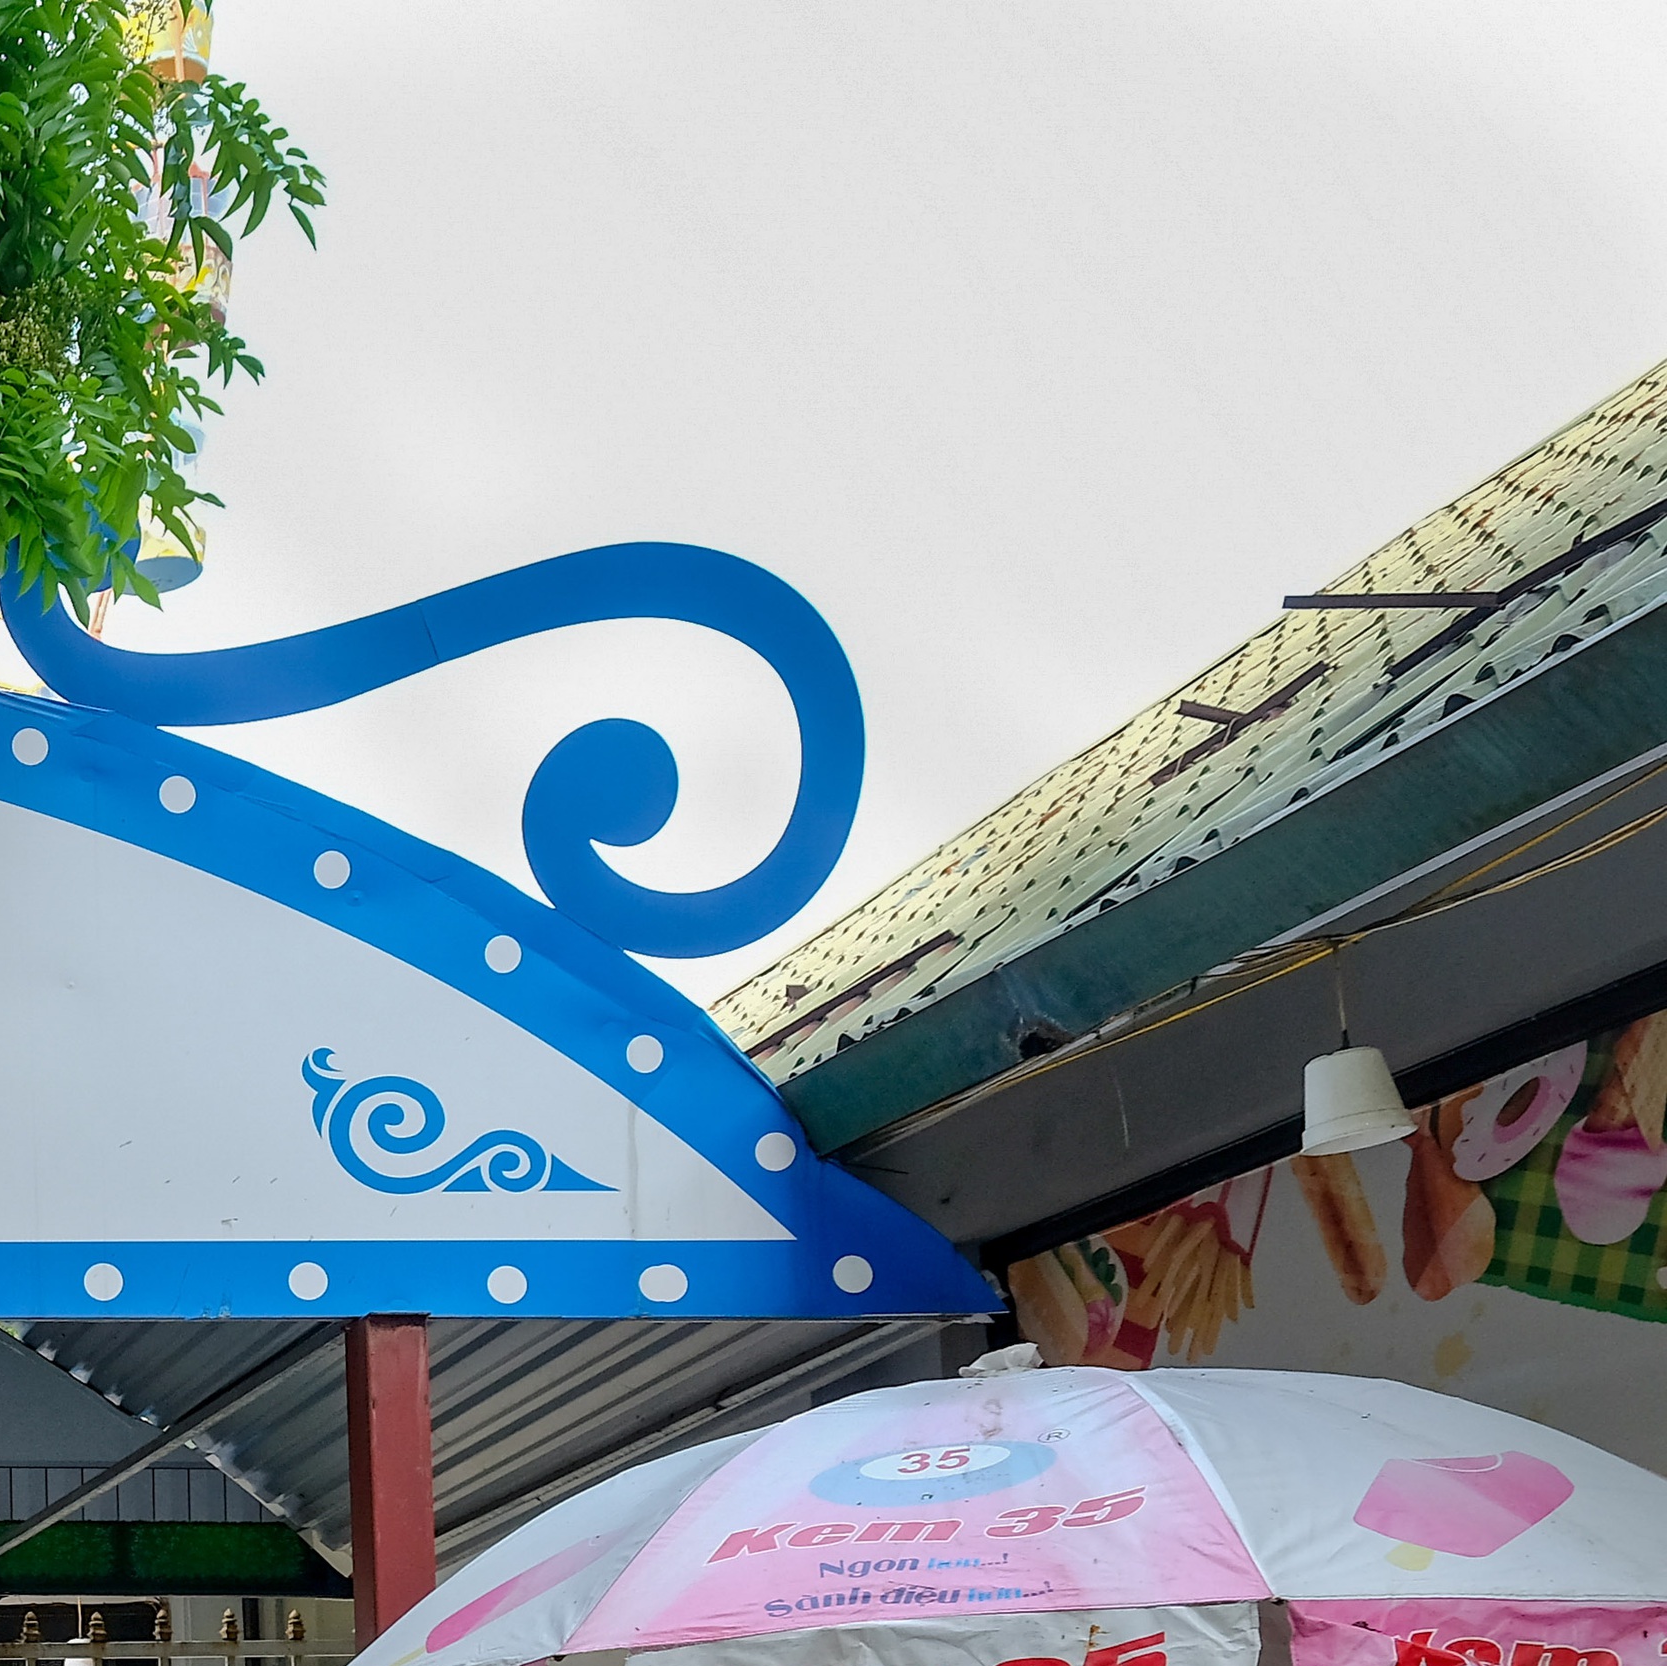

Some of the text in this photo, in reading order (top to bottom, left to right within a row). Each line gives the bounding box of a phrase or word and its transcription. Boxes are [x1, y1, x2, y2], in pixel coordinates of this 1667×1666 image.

[897, 1447, 971, 1475] 35
[704, 1486, 1147, 1566] Kem 35
[819, 1555, 919, 1579] Ngon
